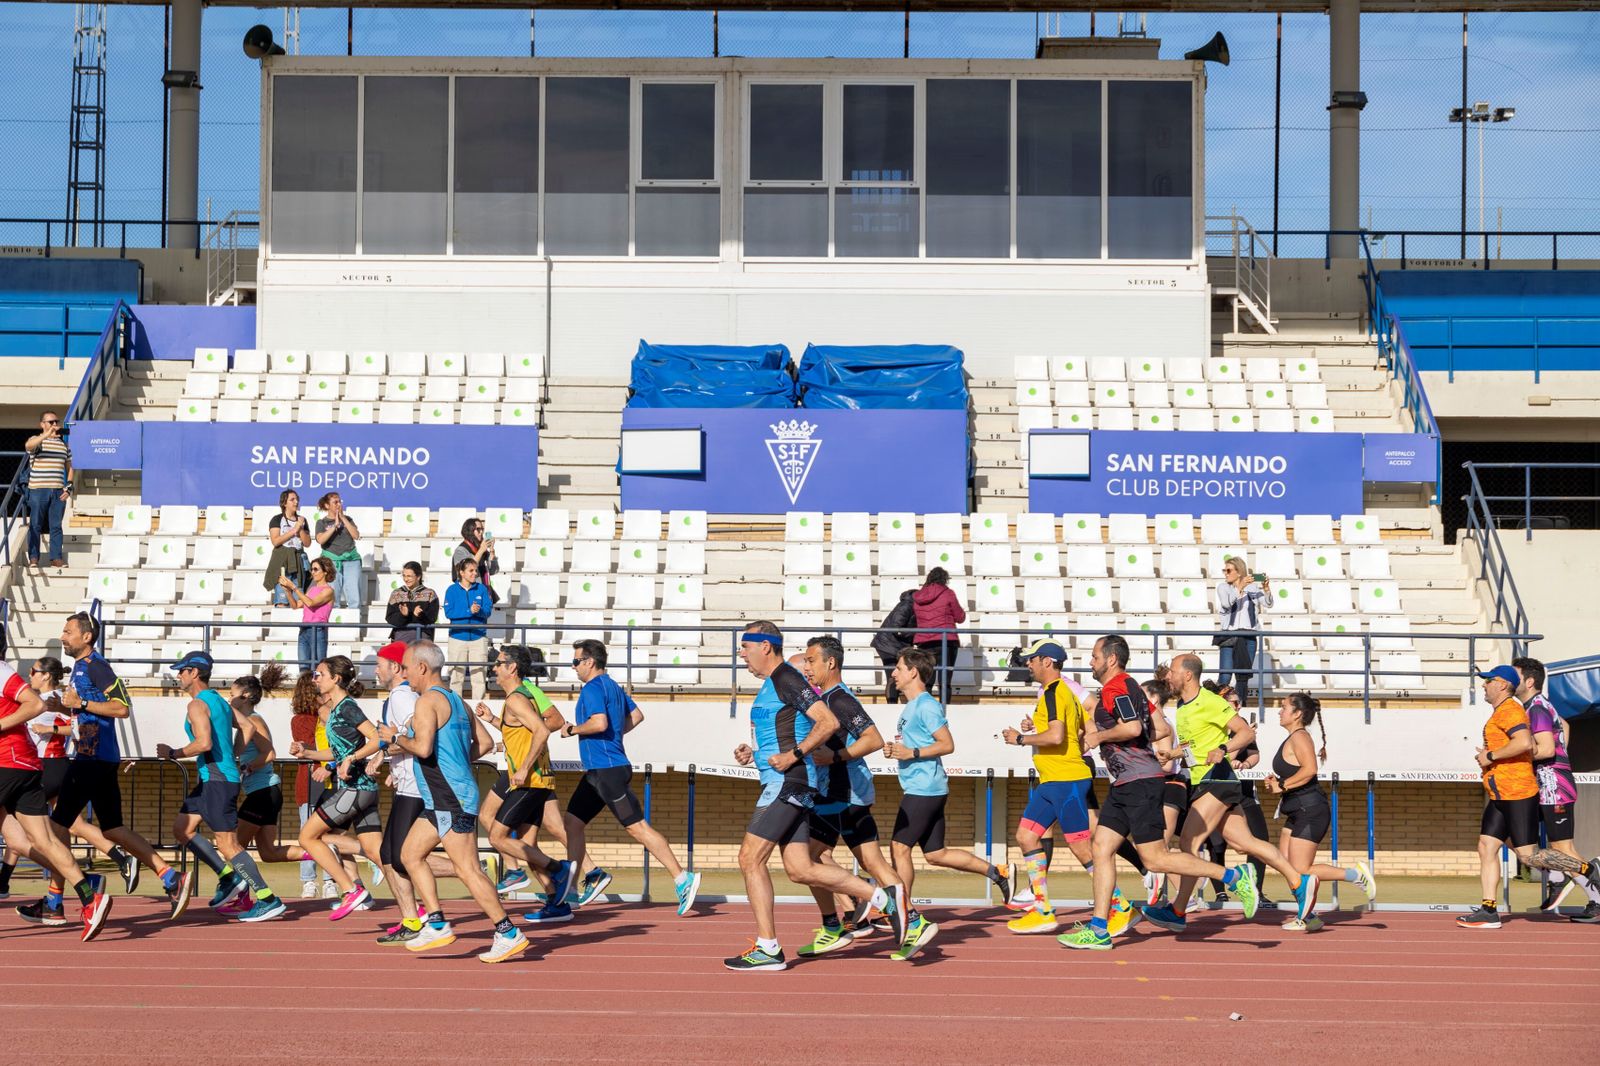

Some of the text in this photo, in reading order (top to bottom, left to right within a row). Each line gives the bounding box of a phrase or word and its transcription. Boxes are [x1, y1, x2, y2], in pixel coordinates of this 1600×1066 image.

[250, 445, 431, 466] SAN FERNANDO
[1106, 453, 1288, 475] SAN FERNANDO
[250, 470, 430, 490] CLUB DEPORTIVO
[1106, 478, 1287, 499] CLUB DEPORTIVO
[722, 768, 737, 776] SAN
[1400, 772, 1416, 780] SAN
[1416, 772, 1459, 780] FERNANDO
